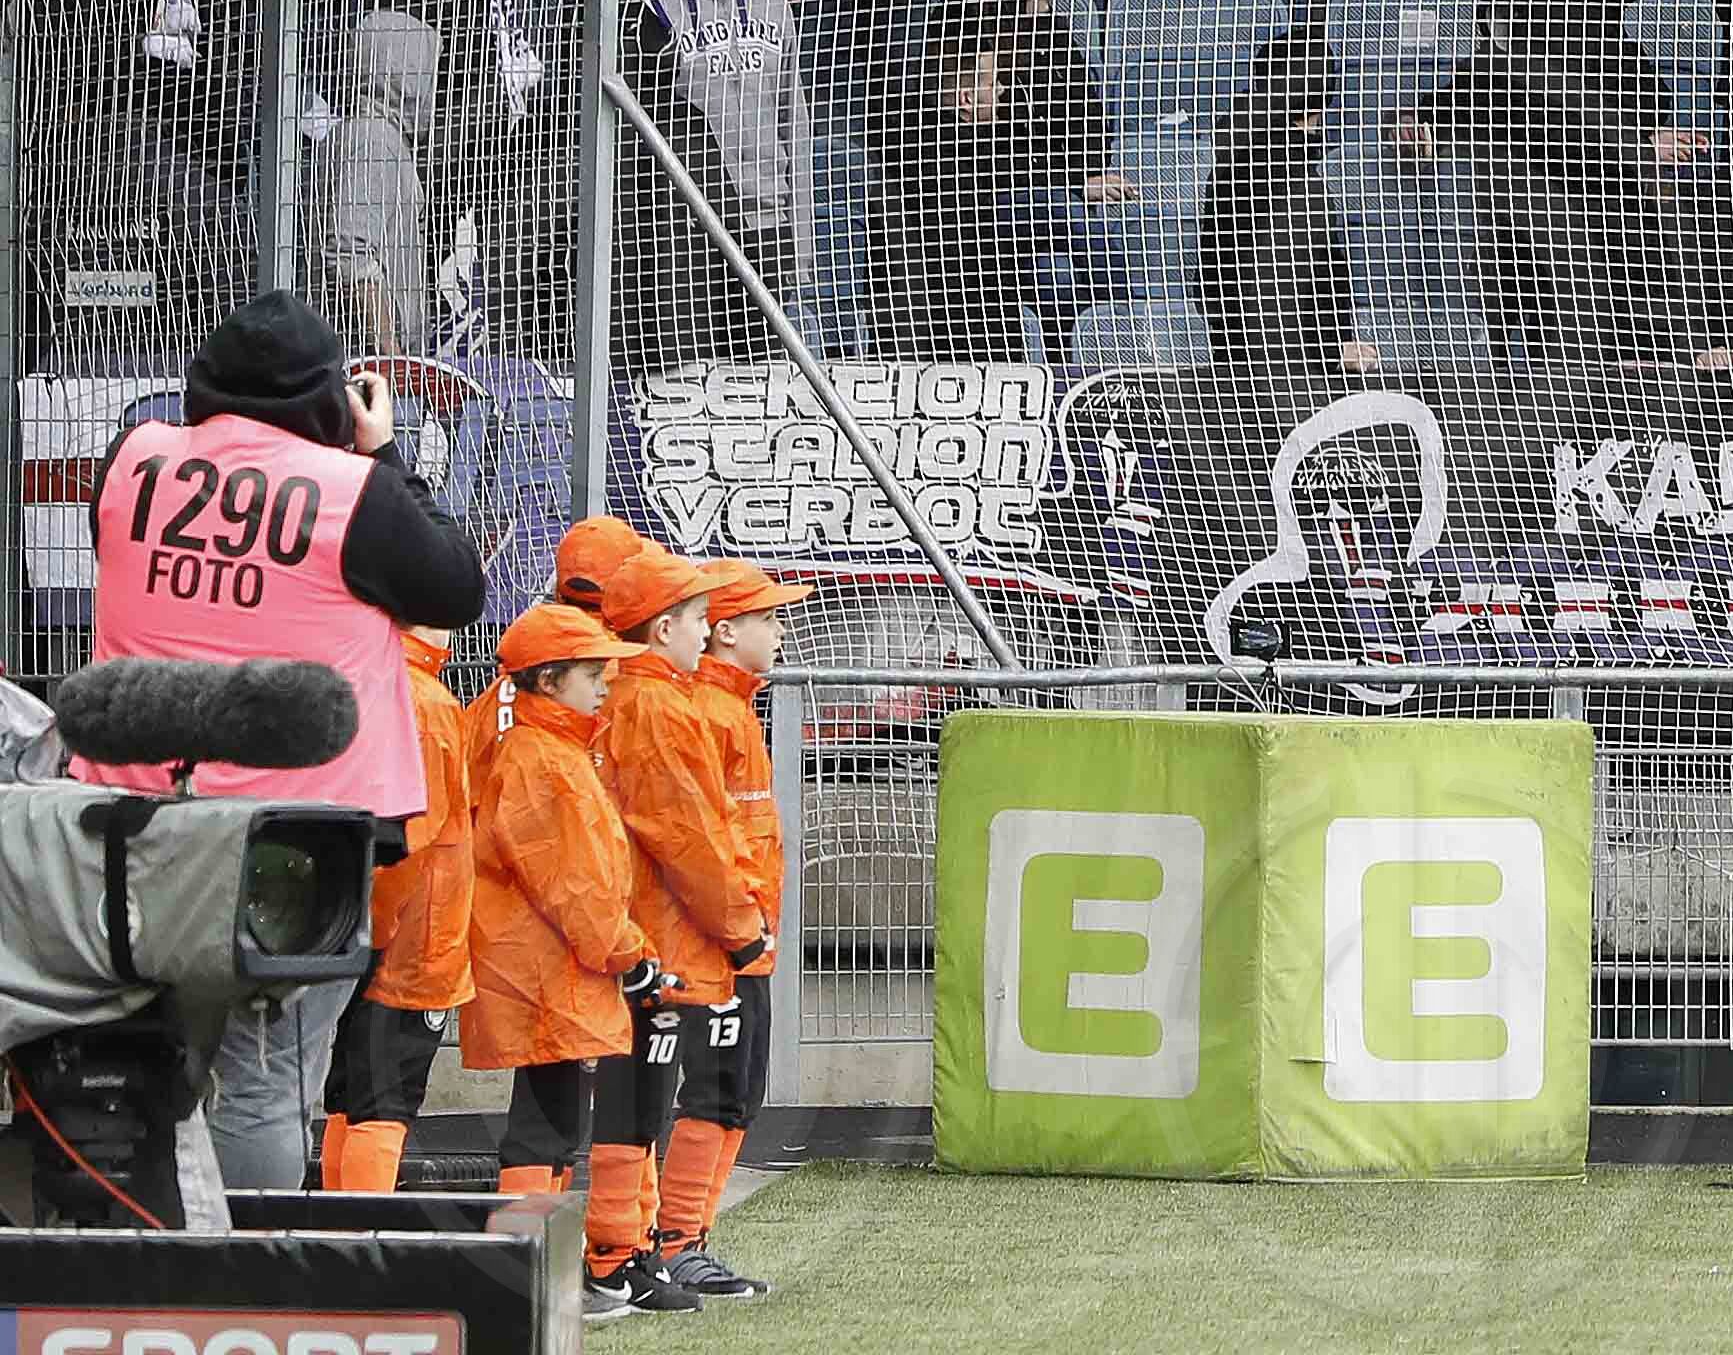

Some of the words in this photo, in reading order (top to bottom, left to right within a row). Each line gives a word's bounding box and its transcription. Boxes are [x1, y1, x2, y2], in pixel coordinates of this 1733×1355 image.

[130, 456, 320, 569] 1290
[146, 550, 264, 609] FOTO
[647, 1033, 678, 1065] 10
[708, 1016, 742, 1048] 13
